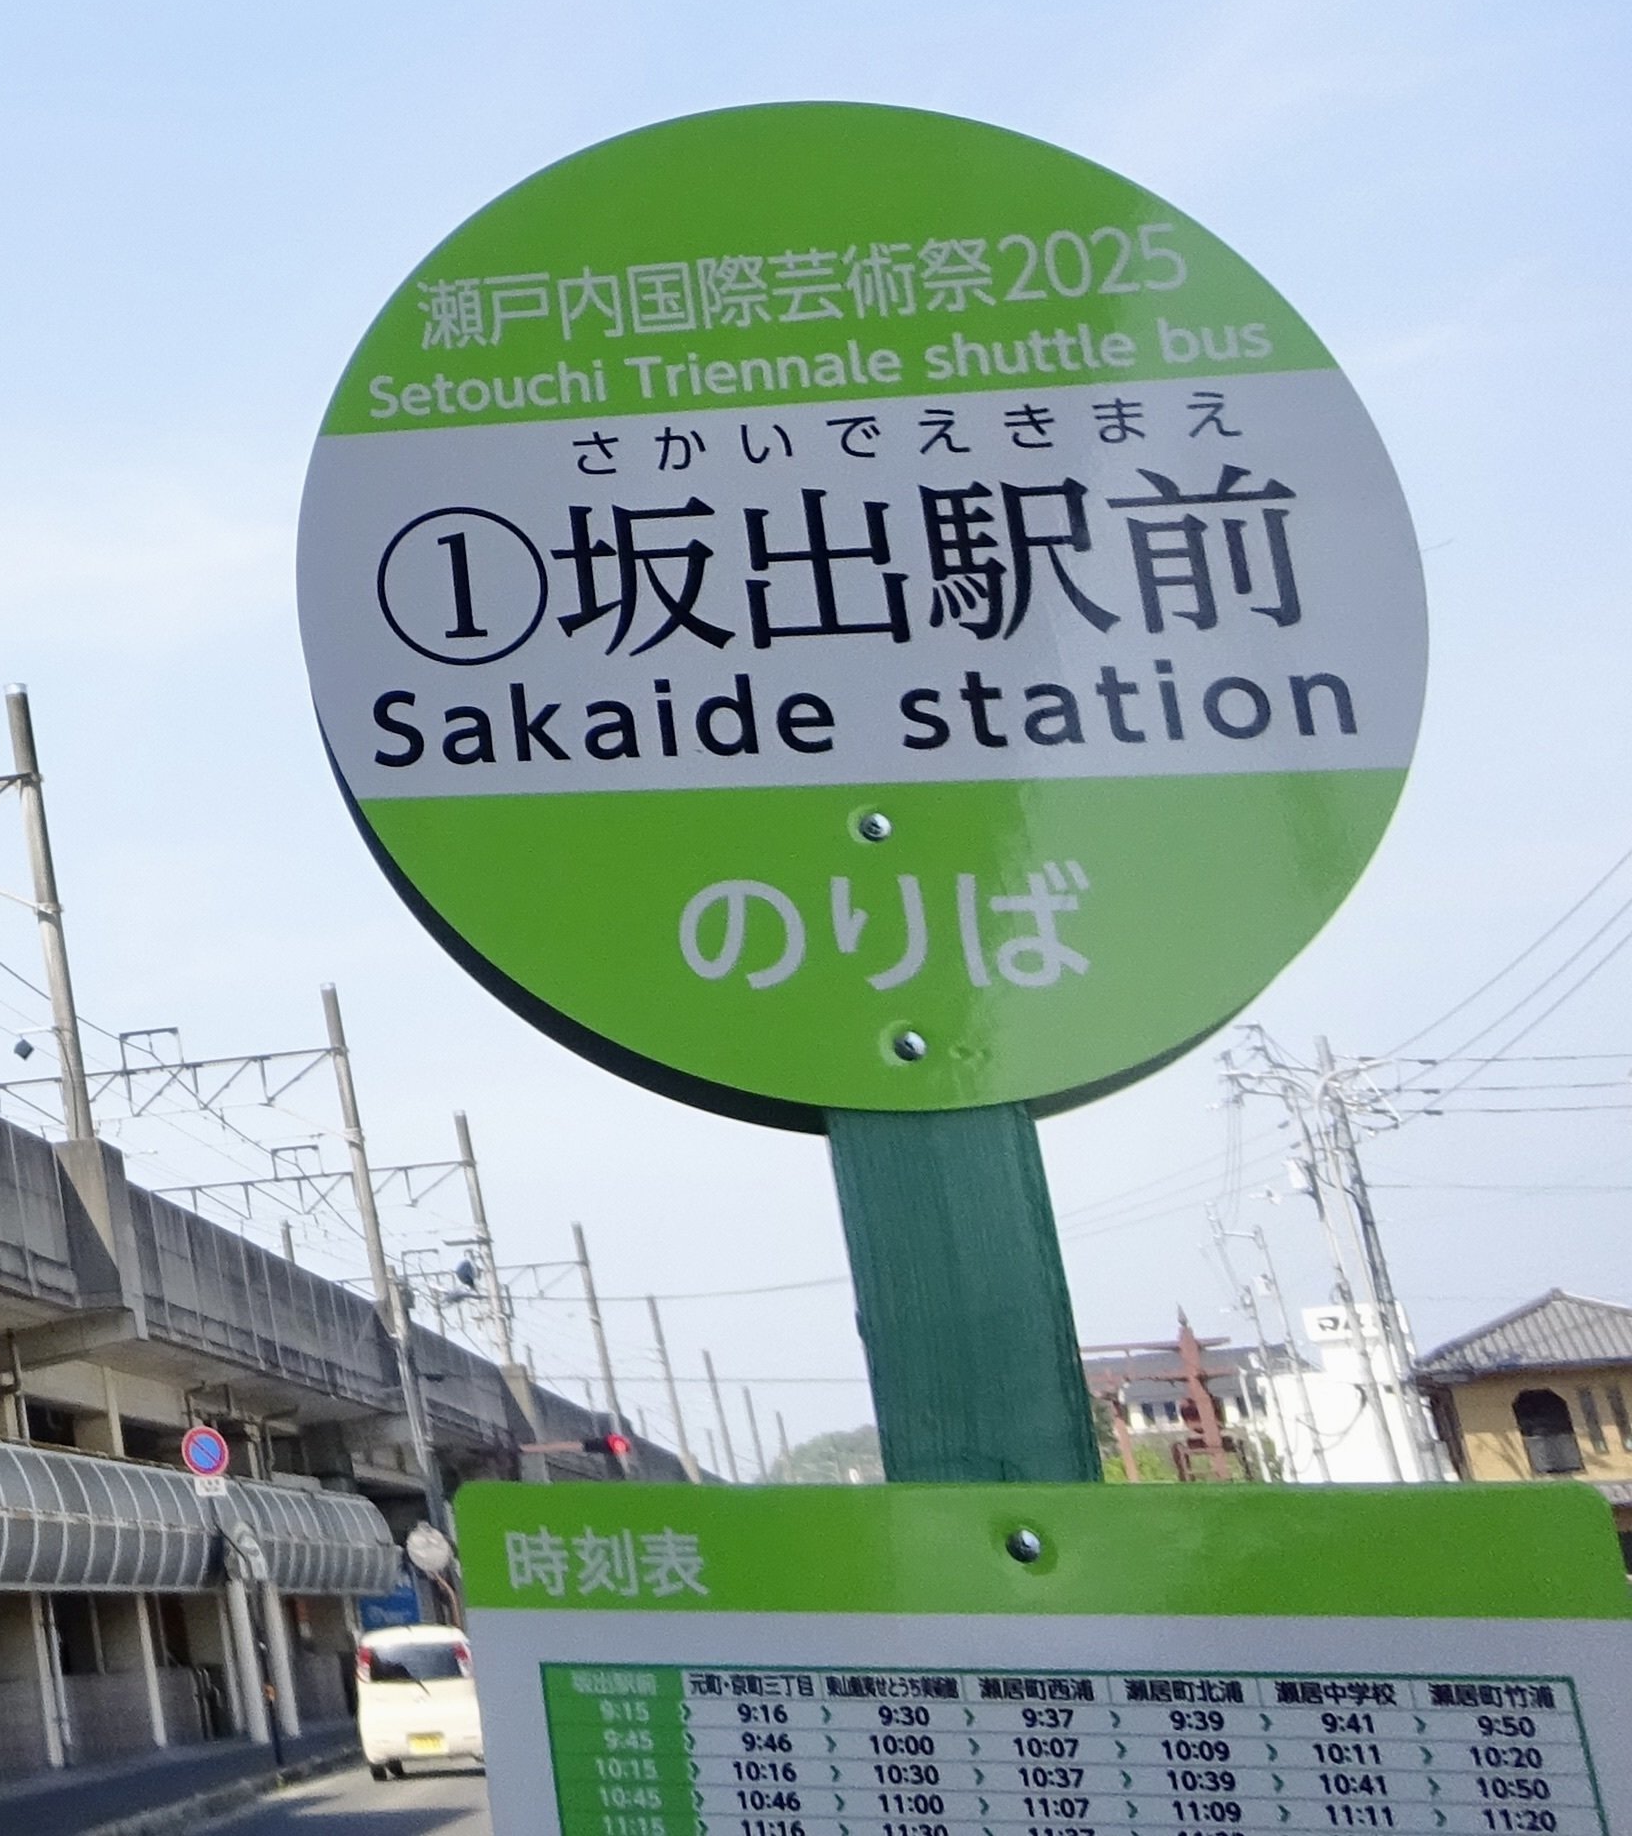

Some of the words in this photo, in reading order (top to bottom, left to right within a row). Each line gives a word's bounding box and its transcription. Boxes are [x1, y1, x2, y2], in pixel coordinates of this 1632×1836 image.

[415, 222, 1189, 351] 瀬戸内国際芸術祭2025
[368, 360, 607, 421] Setouchi
[638, 342, 902, 399] Triennale
[925, 324, 1130, 386] shuttle
[1159, 316, 1272, 365] bus
[573, 390, 1243, 475] さかいでえきまえ
[372, 673, 836, 767] Sakaide
[902, 658, 1359, 753] station
[677, 859, 1092, 991] のりば
[503, 1526, 710, 1599] 時刻表
[737, 1703, 788, 1724] 9:16
[878, 1705, 930, 1727] 9:30
[1021, 1708, 1074, 1728] 9:37
[1170, 1710, 1225, 1731] 9:39
[1321, 1712, 1376, 1734] 9:41
[1477, 1715, 1536, 1737] 9:50
[741, 1732, 793, 1753] 9:46
[869, 1734, 935, 1756] 10:00
[1013, 1737, 1080, 1758] 10:07
[1161, 1739, 1231, 1762] 10:09
[1313, 1743, 1382, 1764] 10:11
[1470, 1745, 1543, 1769] 10:20
[733, 1761, 798, 1782] 10:16
[874, 1764, 940, 1785] 10:30
[1018, 1766, 1085, 1788] 10:37
[1167, 1770, 1236, 1792] 10:39
[1319, 1773, 1387, 1795] 10:41
[1476, 1777, 1551, 1800] 10:50
[737, 1790, 802, 1812] 10:46
[878, 1793, 945, 1815] 11:00
[1023, 1796, 1091, 1819] 11:07
[1172, 1800, 1242, 1823] 11:09
[1325, 1804, 1394, 1826] 11:11
[1483, 1808, 1558, 1833] 11:20
